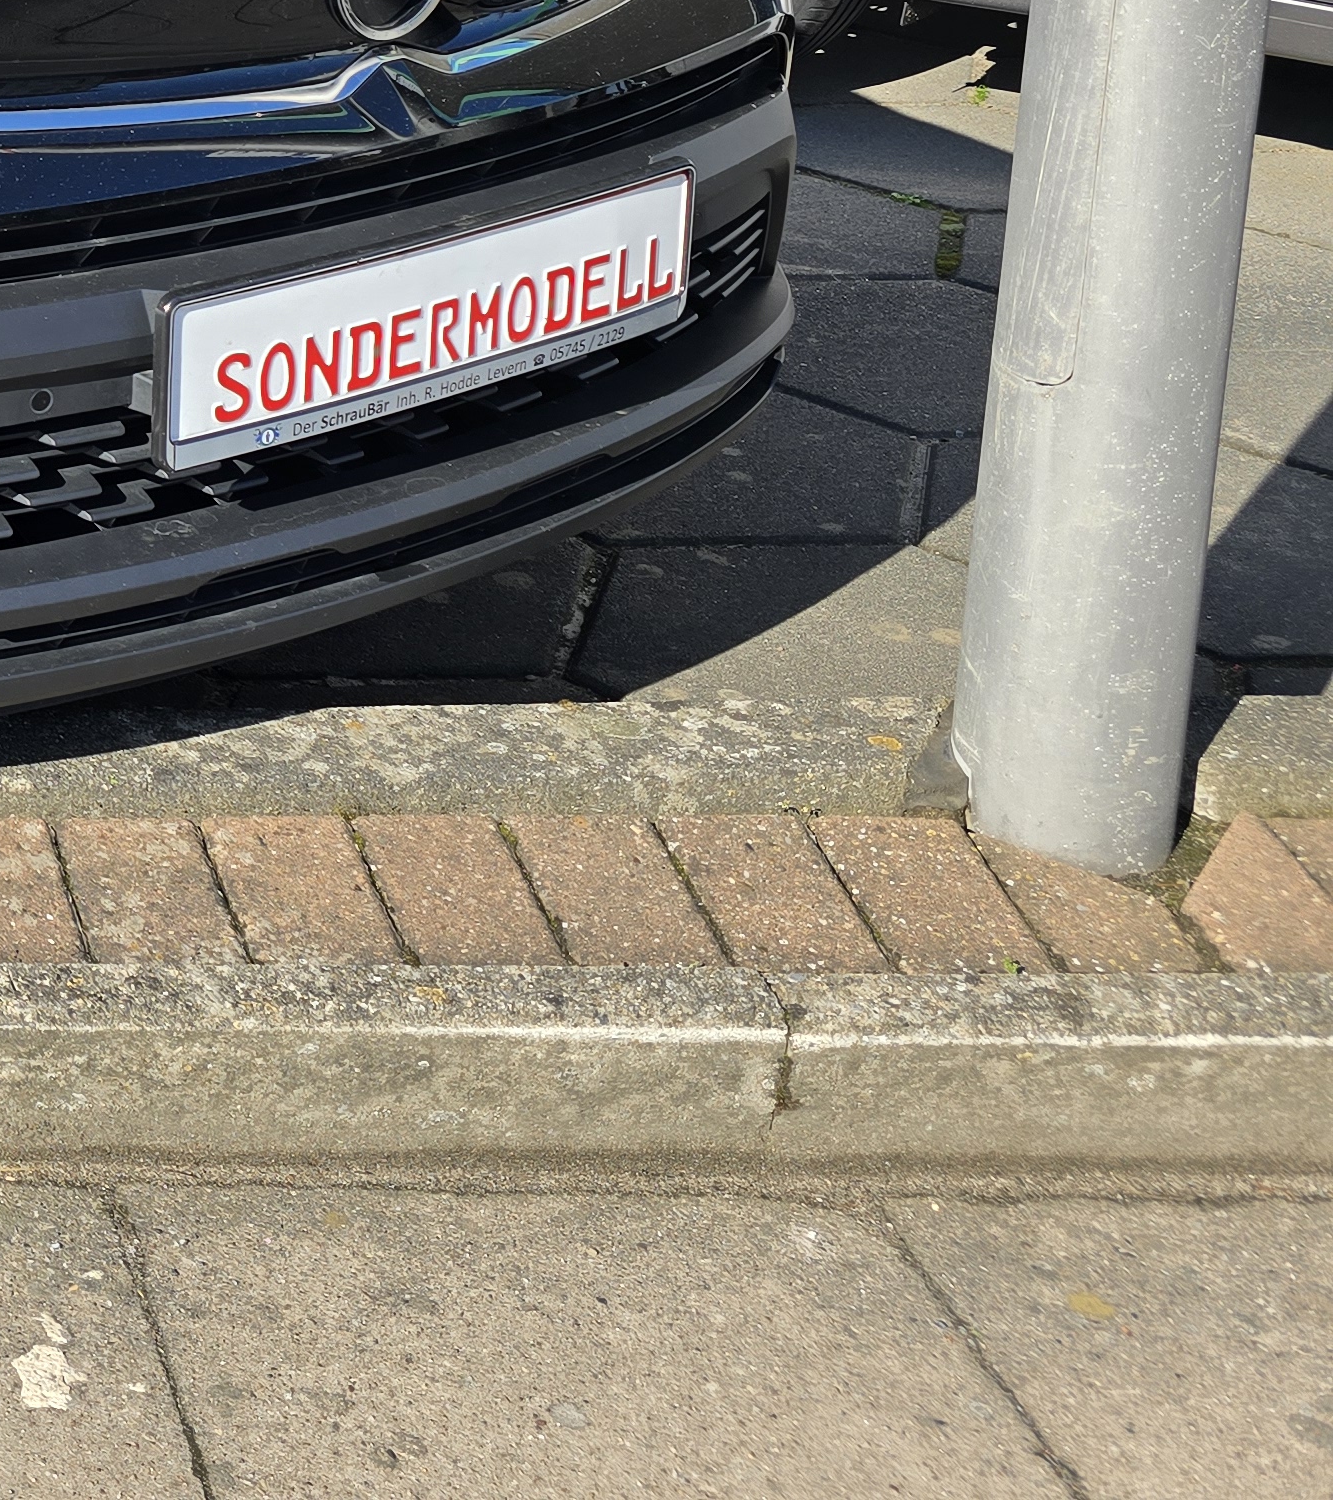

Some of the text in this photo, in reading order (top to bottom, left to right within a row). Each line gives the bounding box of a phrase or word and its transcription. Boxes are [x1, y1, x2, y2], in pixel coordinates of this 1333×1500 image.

[214, 236, 673, 423] SONDERMODELL
[292, 418, 317, 437] Der
[320, 398, 391, 431] SchrauBär
[396, 389, 420, 410] Inh.
[424, 385, 437, 403] R.
[439, 371, 481, 399] Hodde
[487, 358, 528, 382] Levern
[549, 340, 586, 363] 05745
[596, 326, 626, 347] 2129
